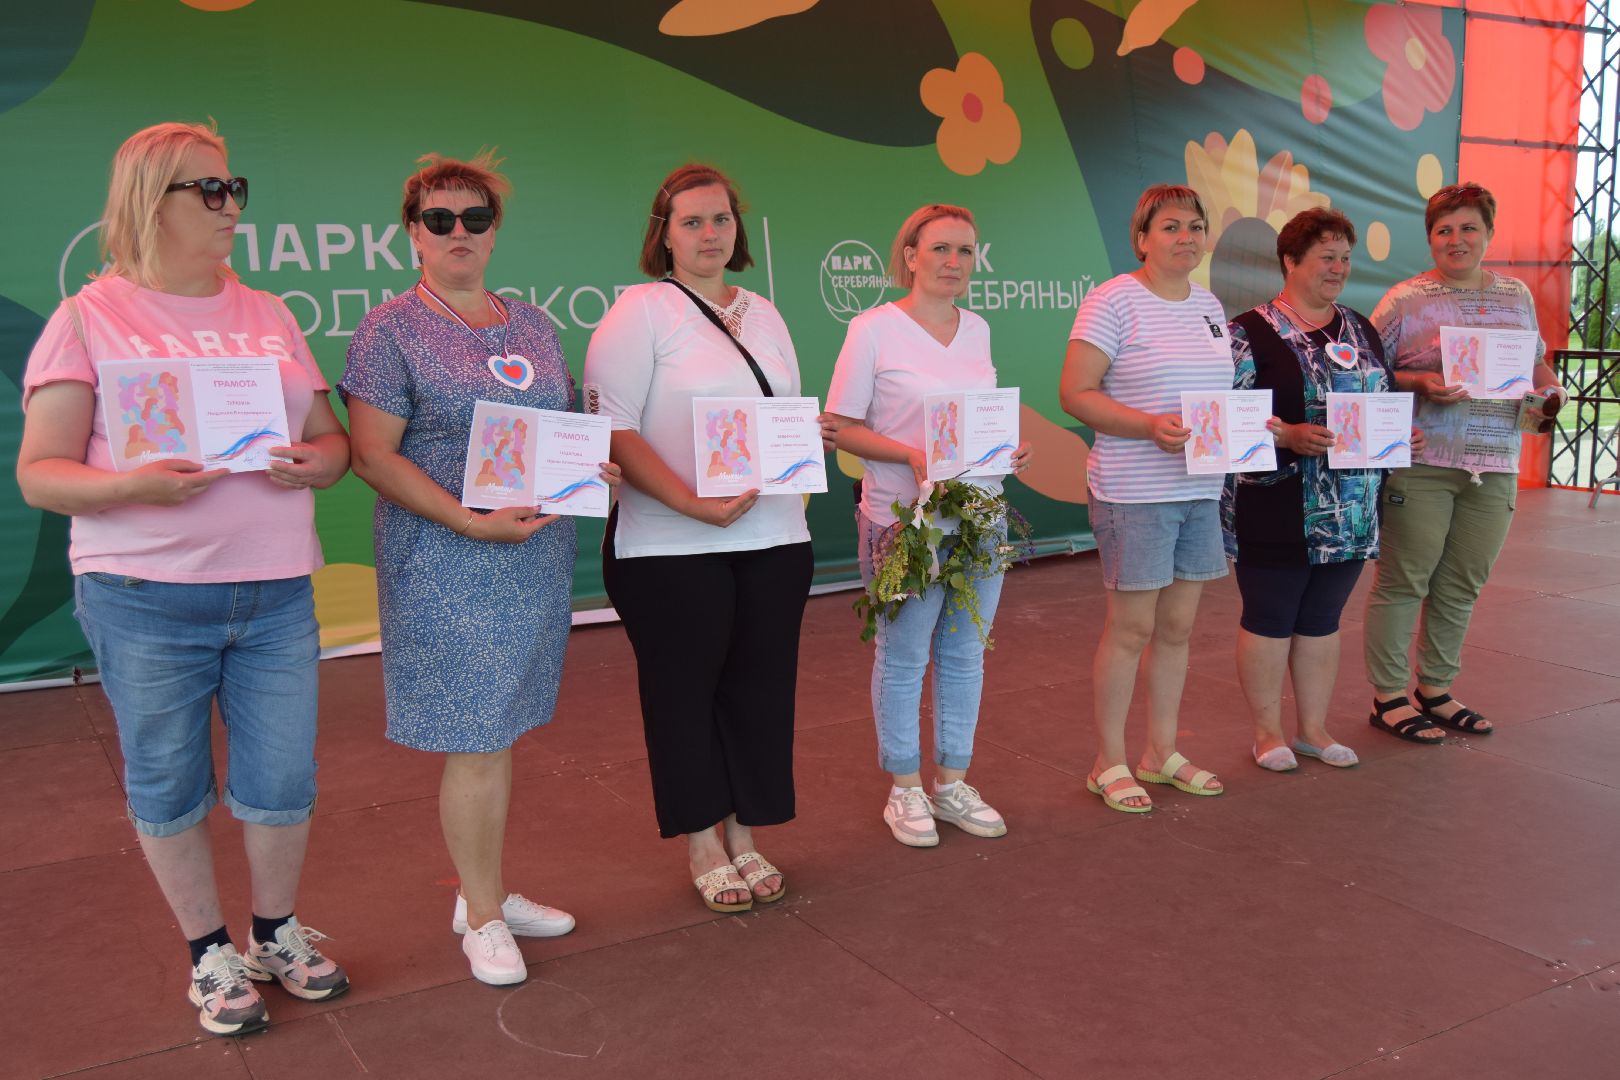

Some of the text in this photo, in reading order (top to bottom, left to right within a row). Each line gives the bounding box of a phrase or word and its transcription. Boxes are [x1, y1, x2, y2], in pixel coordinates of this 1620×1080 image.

[224, 223, 421, 271] ПАРК
[831, 255, 873, 271] ПАРК
[831, 275, 894, 288] СЕРЕБРЯНЫ
[213, 379, 258, 388] ГРАМОТА
[554, 430, 590, 442] ГРАМОТА
